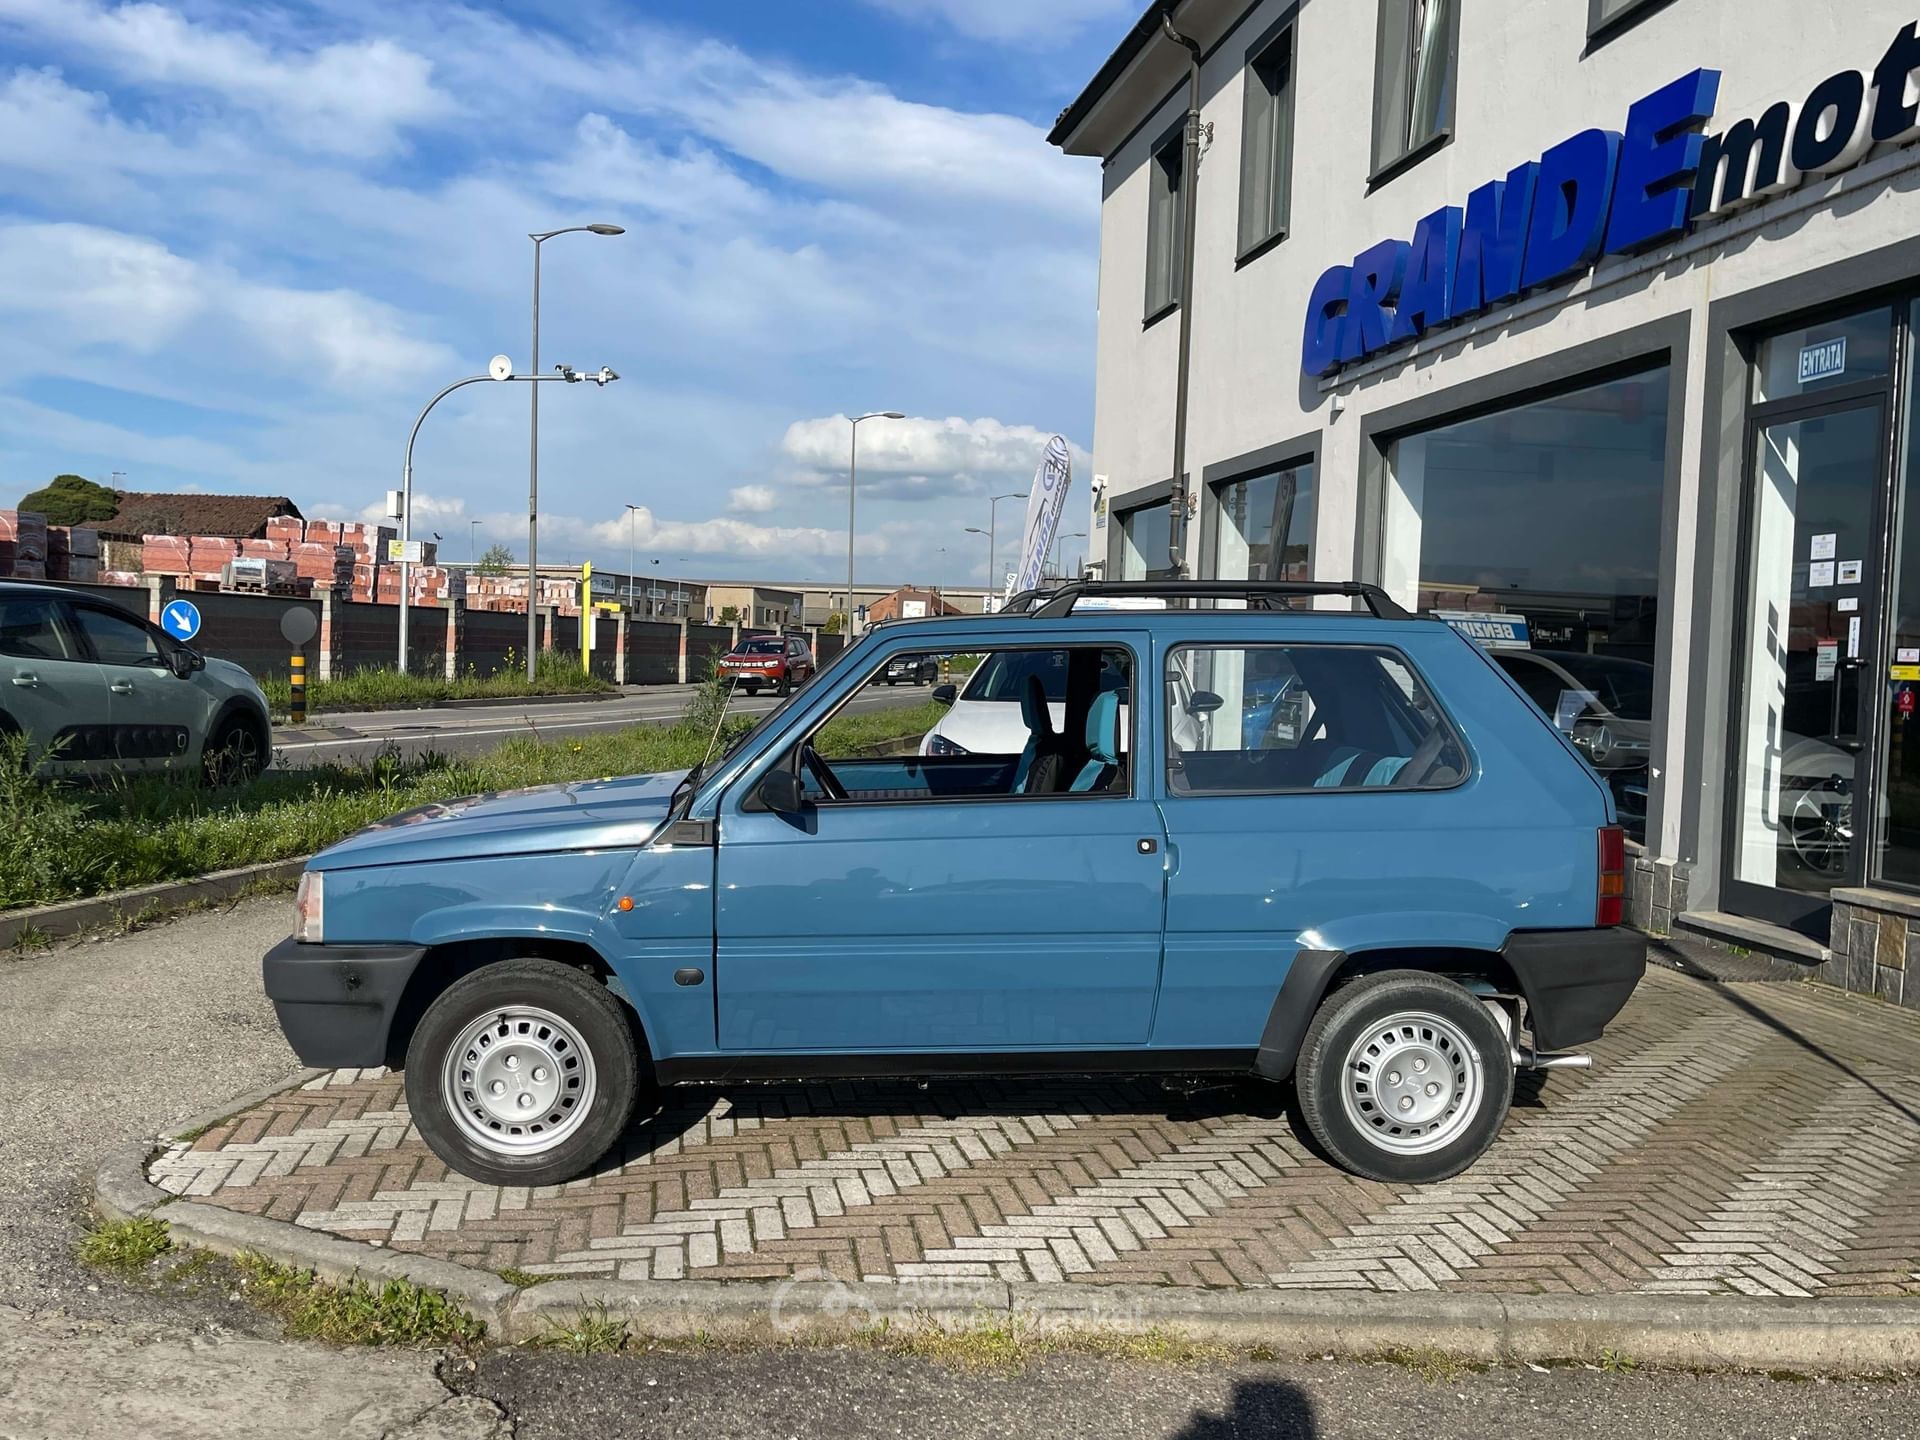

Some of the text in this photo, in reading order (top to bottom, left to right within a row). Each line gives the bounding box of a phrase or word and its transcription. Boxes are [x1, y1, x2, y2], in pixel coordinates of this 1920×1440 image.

[1302, 67, 1721, 377] GRANDE
[1802, 342, 1841, 376] ENTRATA
[1025, 512, 1053, 591] RANDE
